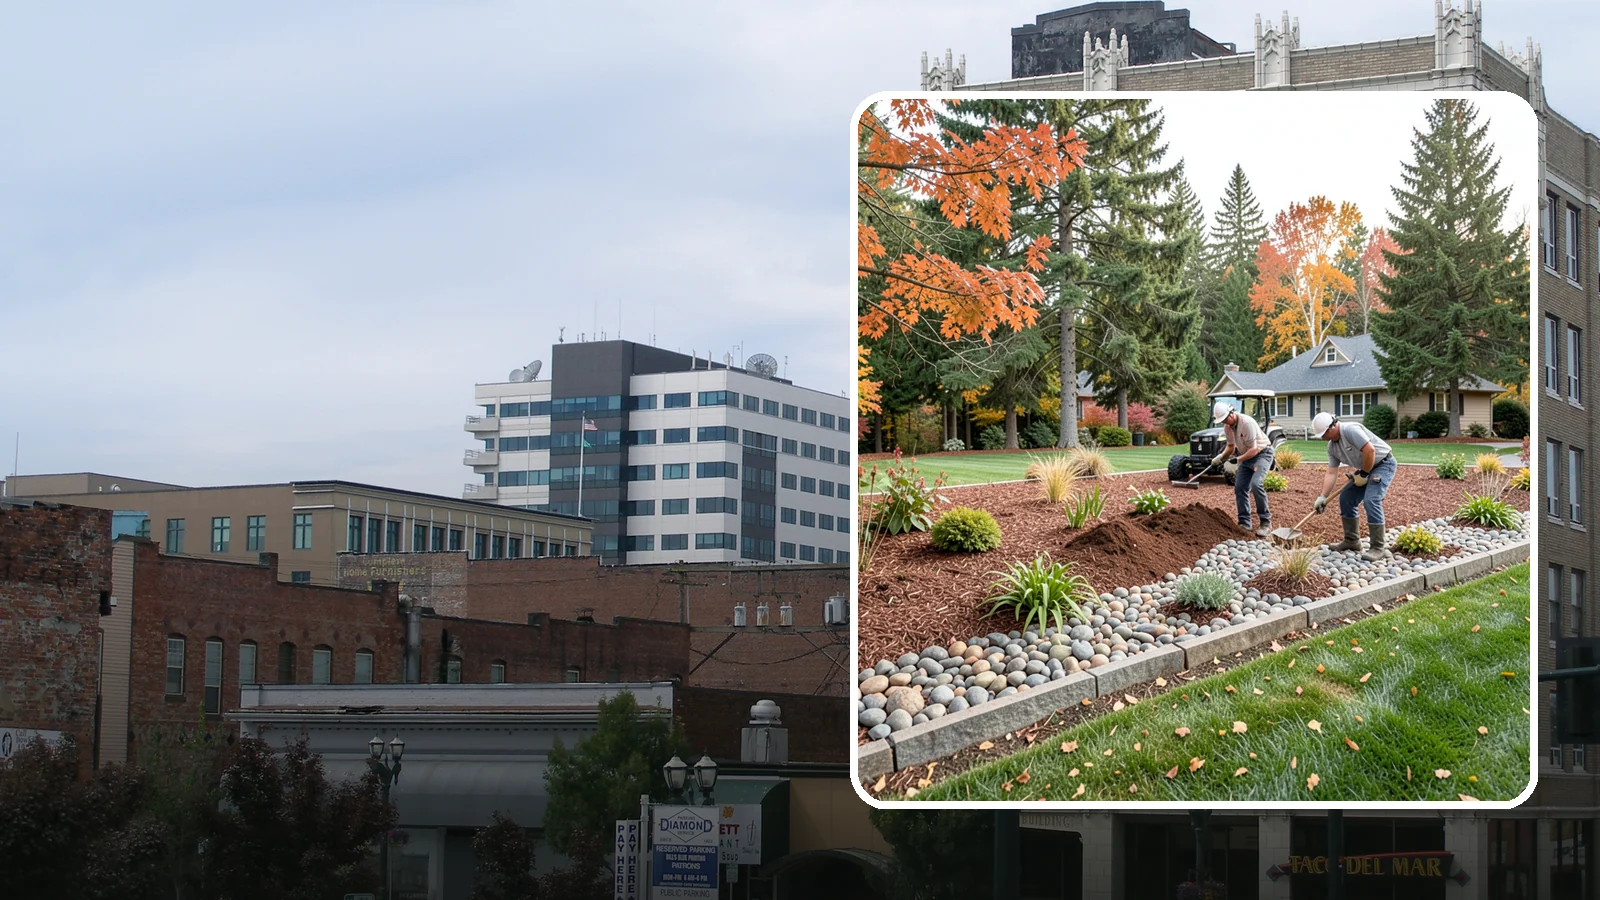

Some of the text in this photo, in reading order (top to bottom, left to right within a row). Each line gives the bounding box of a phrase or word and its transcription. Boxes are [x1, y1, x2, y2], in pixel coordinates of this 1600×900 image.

[343, 566, 427, 577] Home Furnishers
[660, 818, 713, 833] DIAMOND
[1022, 815, 1070, 828] BUILDING
[656, 845, 716, 854] RESERVED PARKING
[616, 824, 625, 894] PAY HERE
[627, 824, 636, 893] PAY HERE
[721, 851, 739, 862] Soup
[671, 862, 701, 870] PATRONS
[1289, 855, 1443, 877] TAC DEL MAR
[660, 889, 710, 898] PUBLIC PARKING
